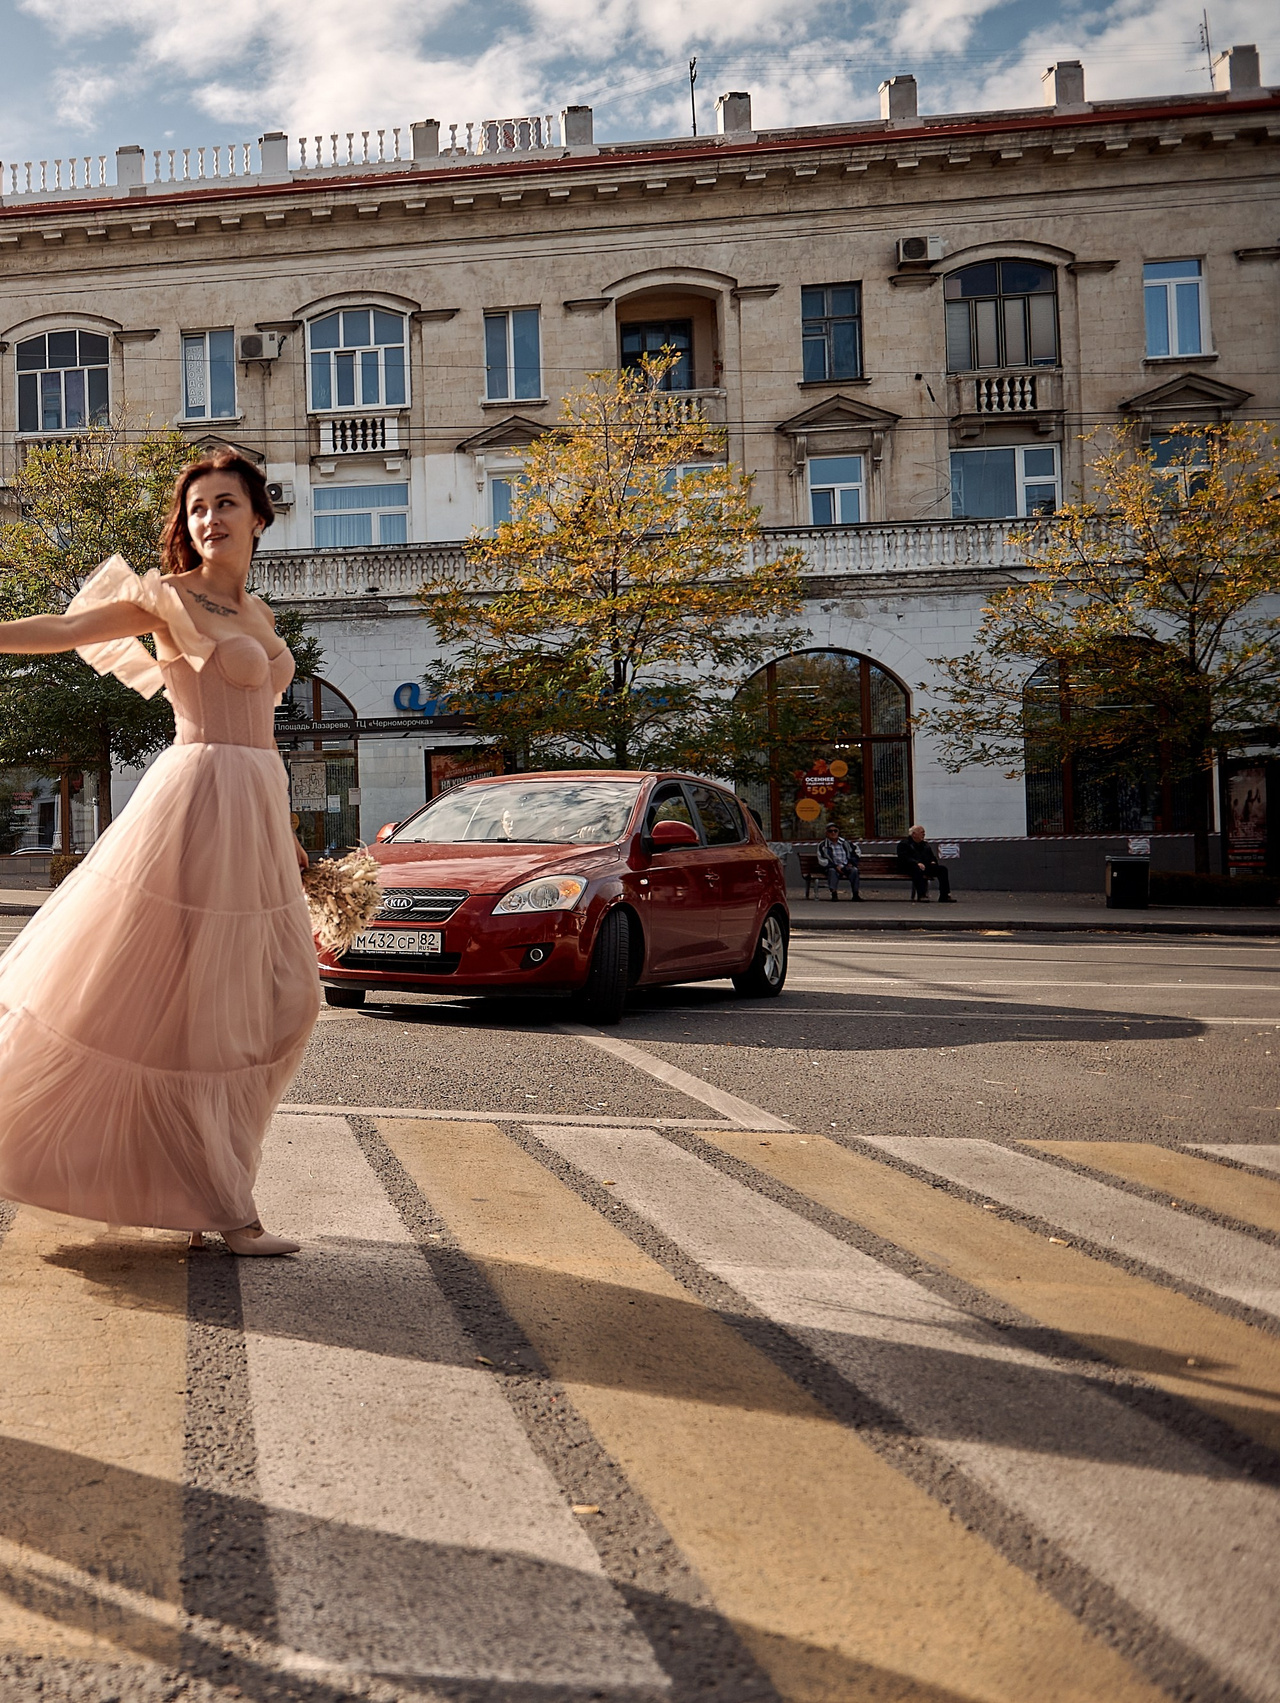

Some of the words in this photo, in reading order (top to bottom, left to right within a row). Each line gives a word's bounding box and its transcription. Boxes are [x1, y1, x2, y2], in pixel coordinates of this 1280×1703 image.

[274, 723, 310, 732] Площадь
[312, 721, 351, 731] Лазарева,
[355, 720, 367, 729] ТЦ
[368, 718, 434, 728] «Черноморочка»
[390, 899, 408, 907] KIA
[356, 933, 416, 949] М432СР
[420, 933, 435, 945] 82
